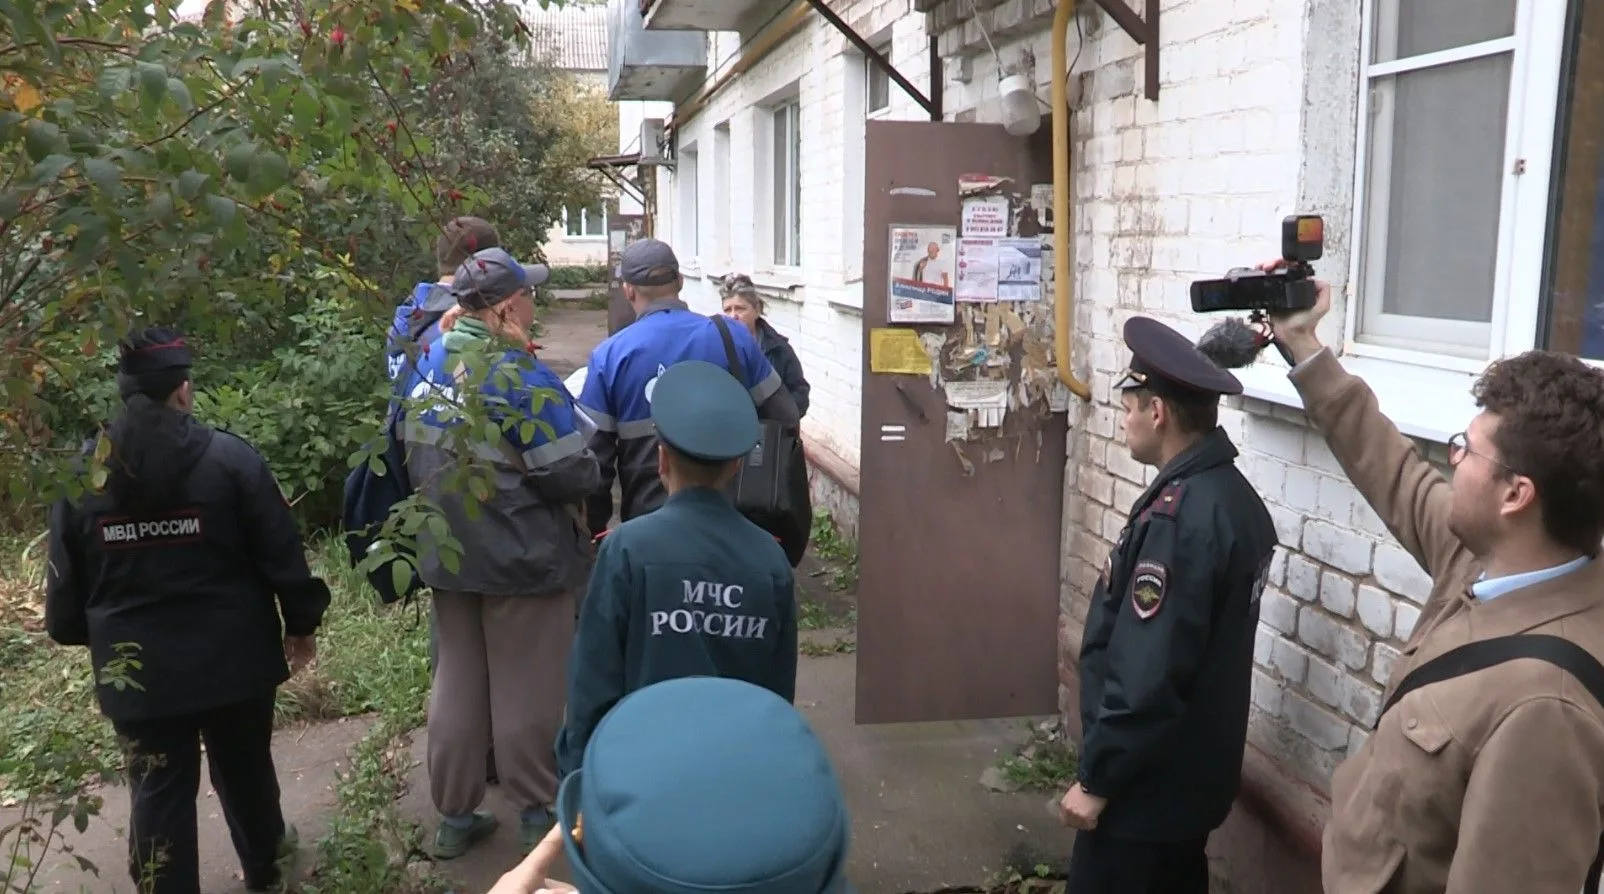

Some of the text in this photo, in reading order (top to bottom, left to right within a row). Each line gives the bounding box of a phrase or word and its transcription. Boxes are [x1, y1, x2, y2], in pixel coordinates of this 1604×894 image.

[103, 517, 200, 541] МВД РОССИИ
[681, 580, 744, 608] МЧС
[649, 609, 769, 639] РОССИИ
